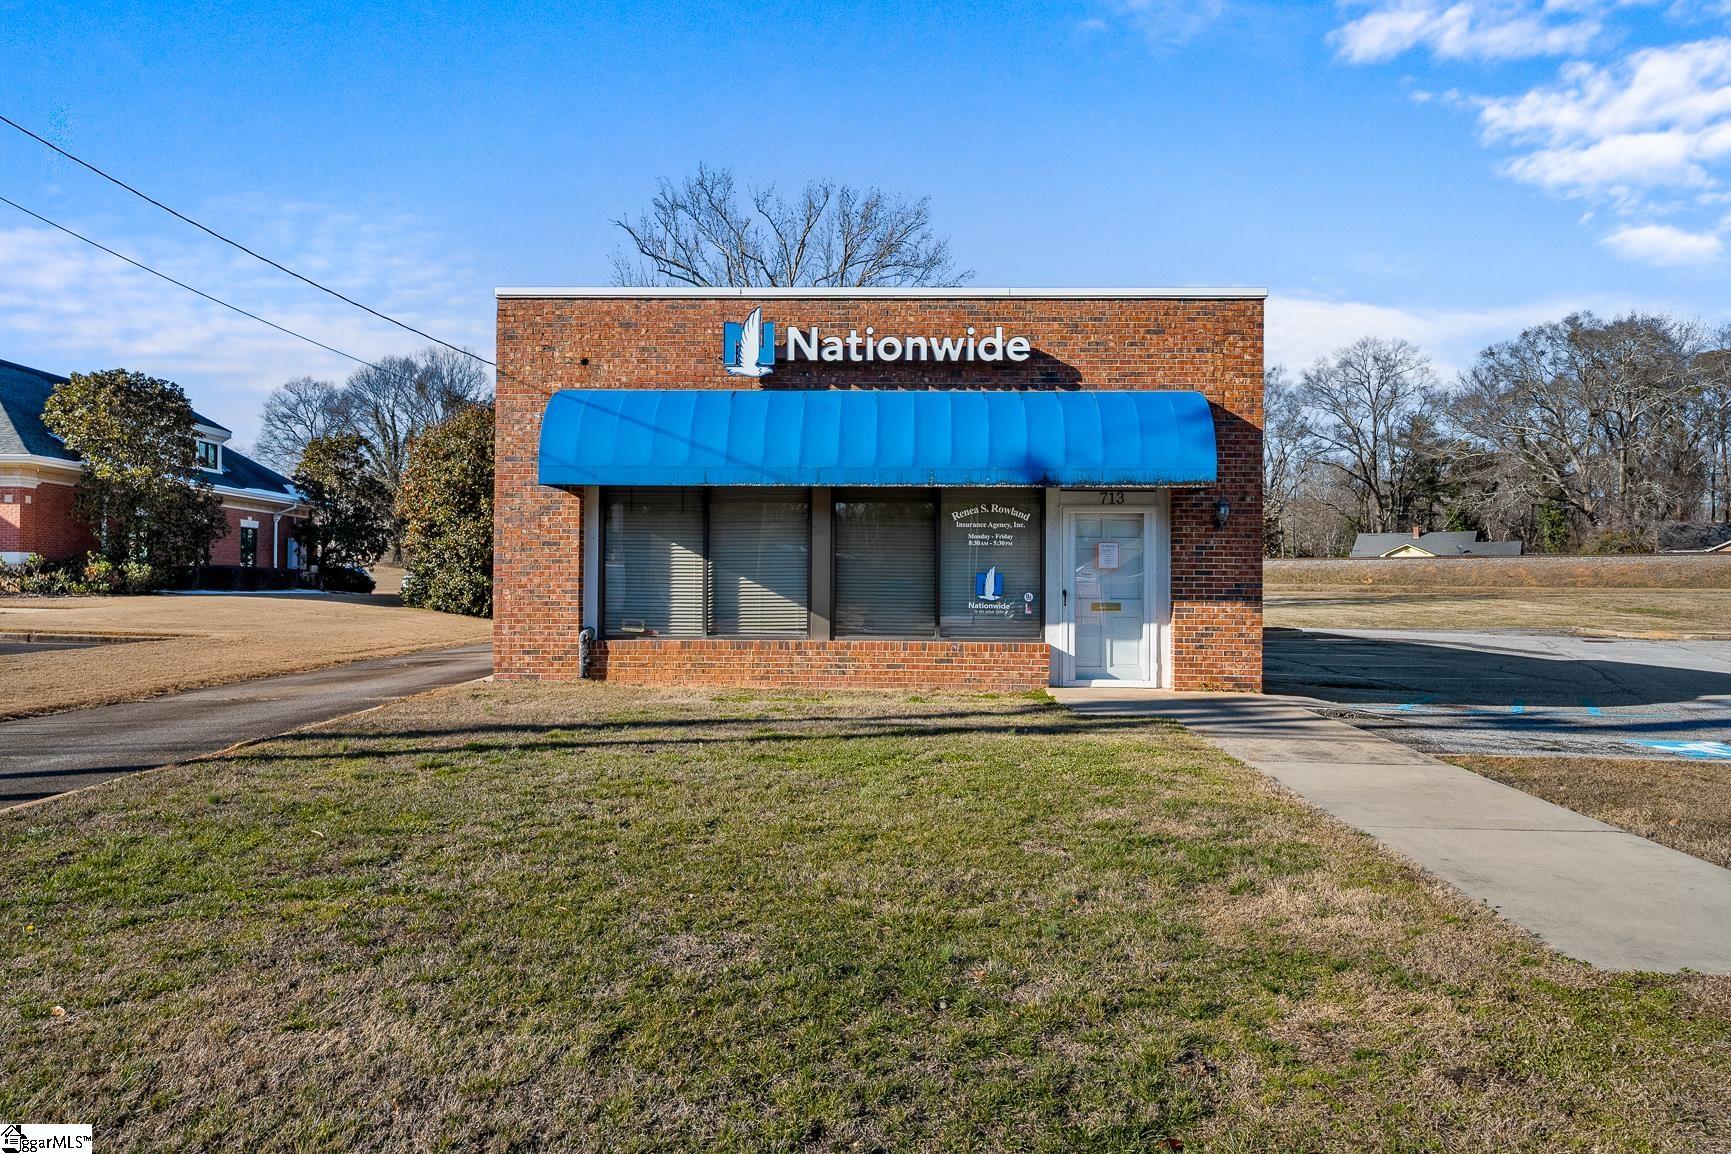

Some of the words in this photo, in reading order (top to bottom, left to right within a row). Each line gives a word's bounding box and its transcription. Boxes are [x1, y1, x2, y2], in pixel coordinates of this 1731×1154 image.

[786, 326, 1031, 362] Nationwide
[1099, 492, 1125, 505] 713
[952, 507, 979, 521] Renea
[980, 503, 989, 513] S.
[991, 503, 1030, 521] Rowland
[987, 521, 1012, 530] Agency,
[968, 533, 990, 541] Monday
[995, 533, 1013, 541] Friday
[968, 602, 1011, 610] Nationwide
